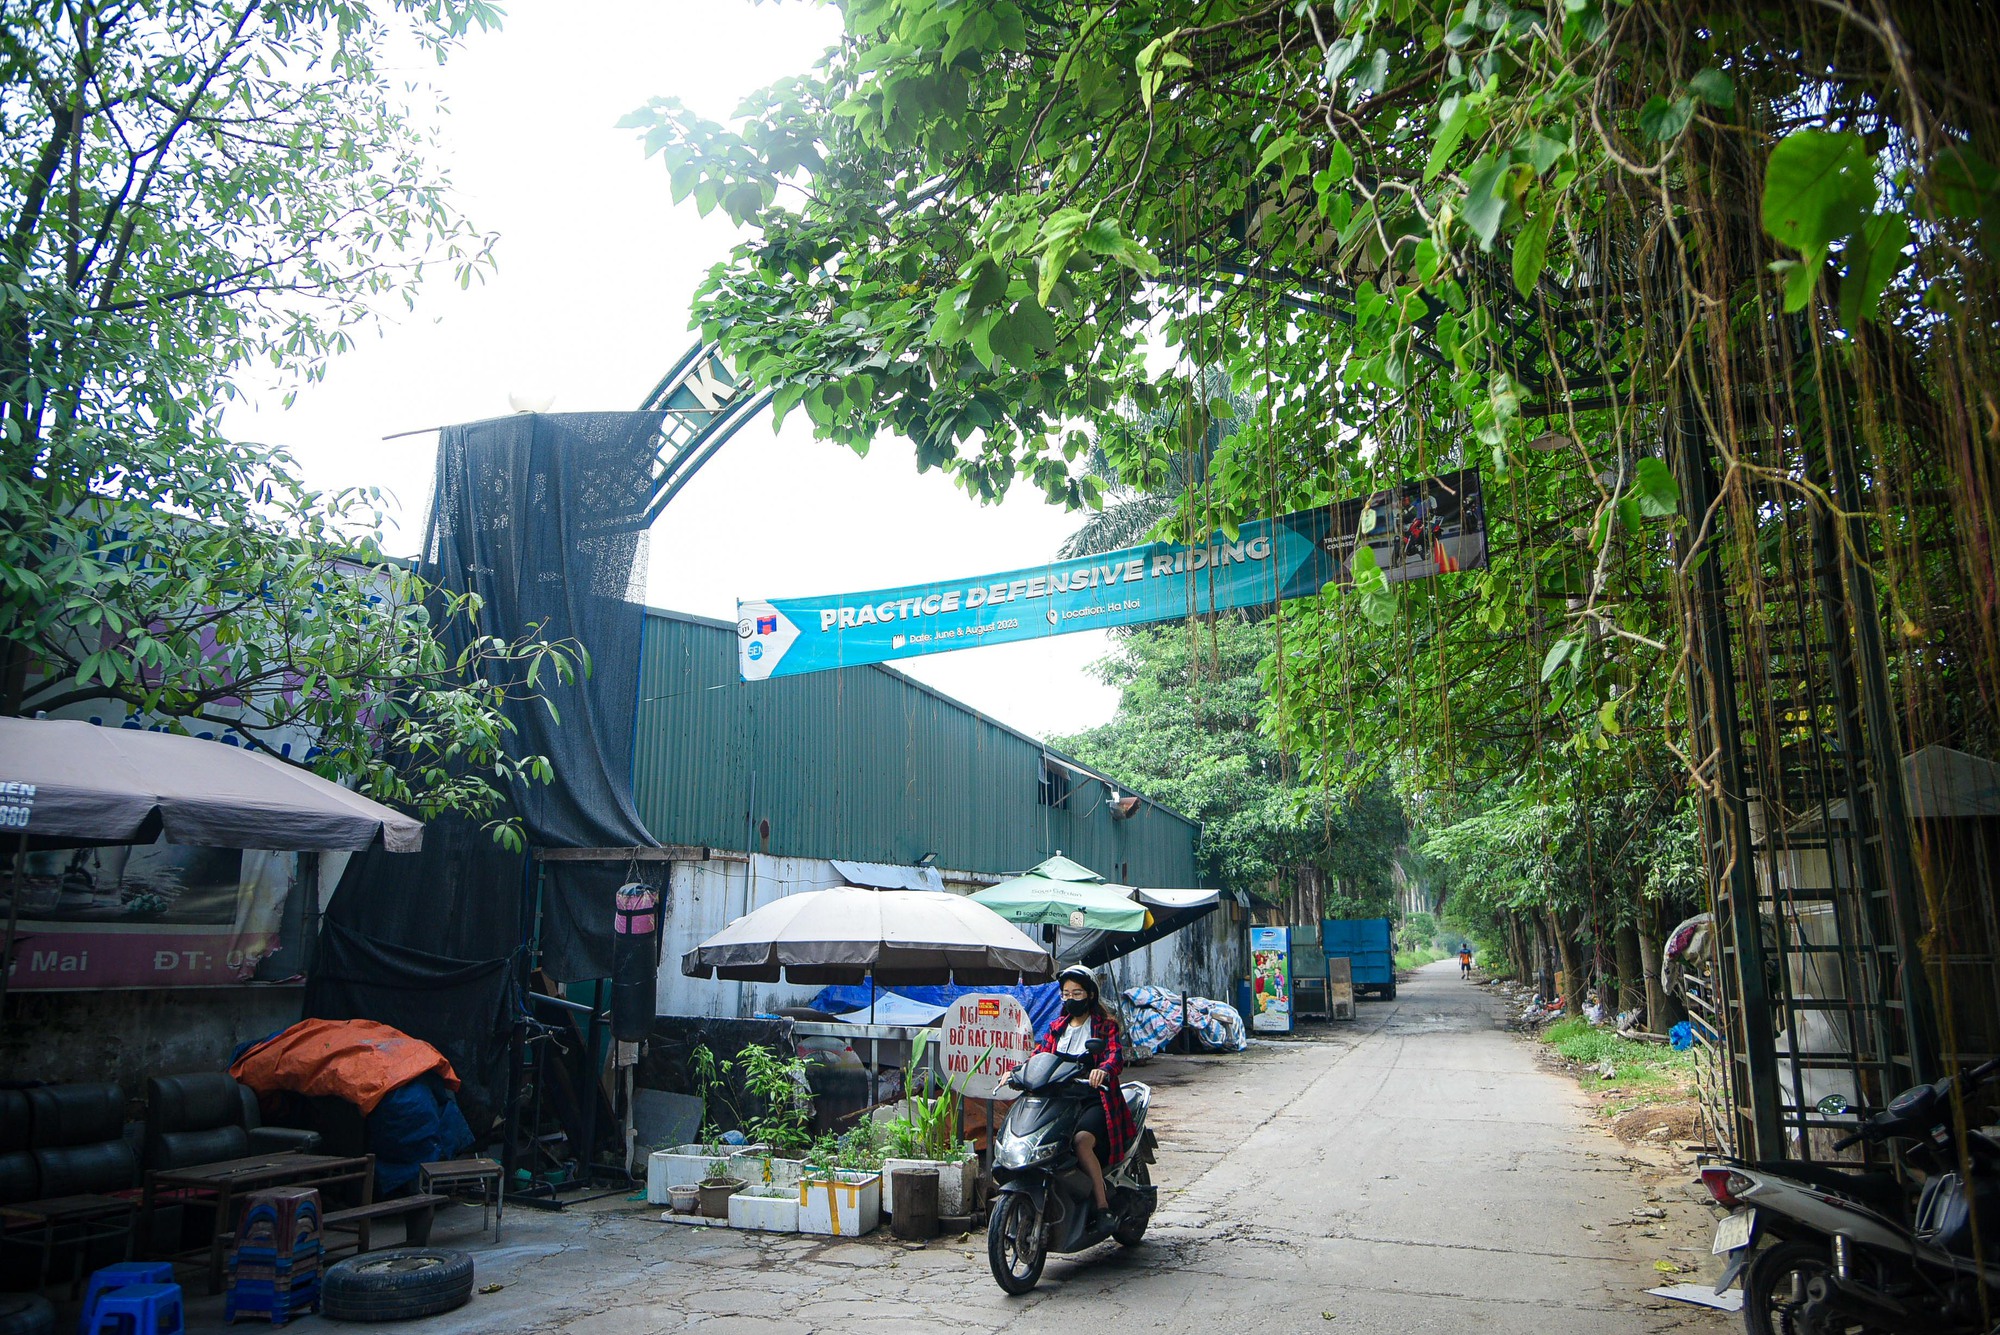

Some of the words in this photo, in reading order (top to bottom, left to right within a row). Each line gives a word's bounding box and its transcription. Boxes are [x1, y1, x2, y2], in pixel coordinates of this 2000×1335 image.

[1324, 534, 1355, 543] TRAINING
[820, 590, 961, 632] PRACTICE
[966, 557, 1143, 609] DEFENSIVE
[1151, 536, 1271, 578] RIDING
[1062, 605, 1105, 620] Location:
[1108, 602, 1121, 612] Ha
[1123, 598, 1140, 609] Noi
[910, 634, 932, 643] Date:
[934, 630, 955, 640] June
[956, 627, 963, 636] &
[965, 622, 995, 635] August
[997, 618, 1018, 630] 2023
[31, 951, 88, 971] Mai
[153, 951, 212, 970] ĐT:
[948, 1050, 968, 1072] VÀO
